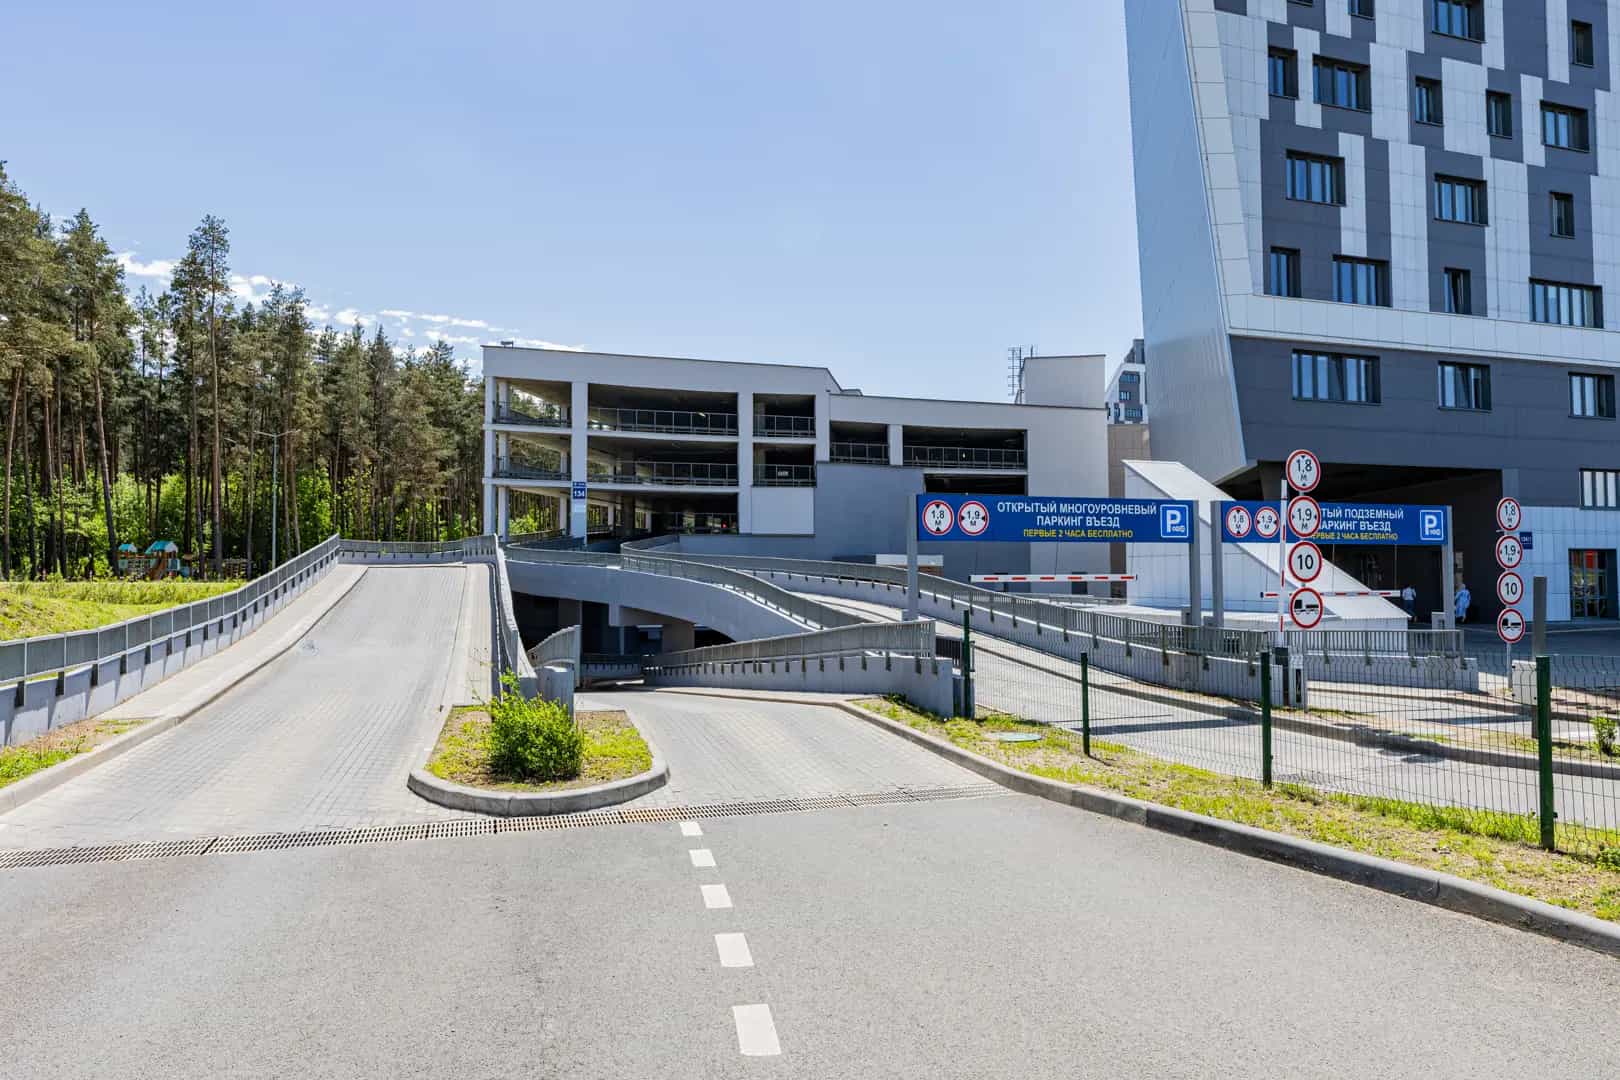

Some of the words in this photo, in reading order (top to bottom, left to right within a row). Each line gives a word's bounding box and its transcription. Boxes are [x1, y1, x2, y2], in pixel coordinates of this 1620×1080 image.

[997, 501, 1057, 513] ОТКРЫТЫЙ
[1060, 502, 1157, 515] МНОГОУРОВНЕВЫЙ
[1321, 507, 1341, 518] ТЫЙ
[1344, 508, 1404, 520] ПОДЗЕМНЫЙ
[1036, 515, 1084, 527] ПАРКИНГ
[1086, 516, 1120, 528] ВЪЕЗД
[1360, 521, 1392, 532] ВЪЕЗД
[1023, 528, 1057, 537] ПЕРВЫЕ
[1058, 529, 1063, 537] 2
[1065, 529, 1086, 538] ЧАСА
[1087, 529, 1134, 538] БЕСПЛАТНО
[1342, 532, 1359, 540] ЧАСА
[1360, 532, 1398, 540] БЕСПЛАТНО
[1297, 554, 1314, 570] 10
[1505, 582, 1518, 595] 10
